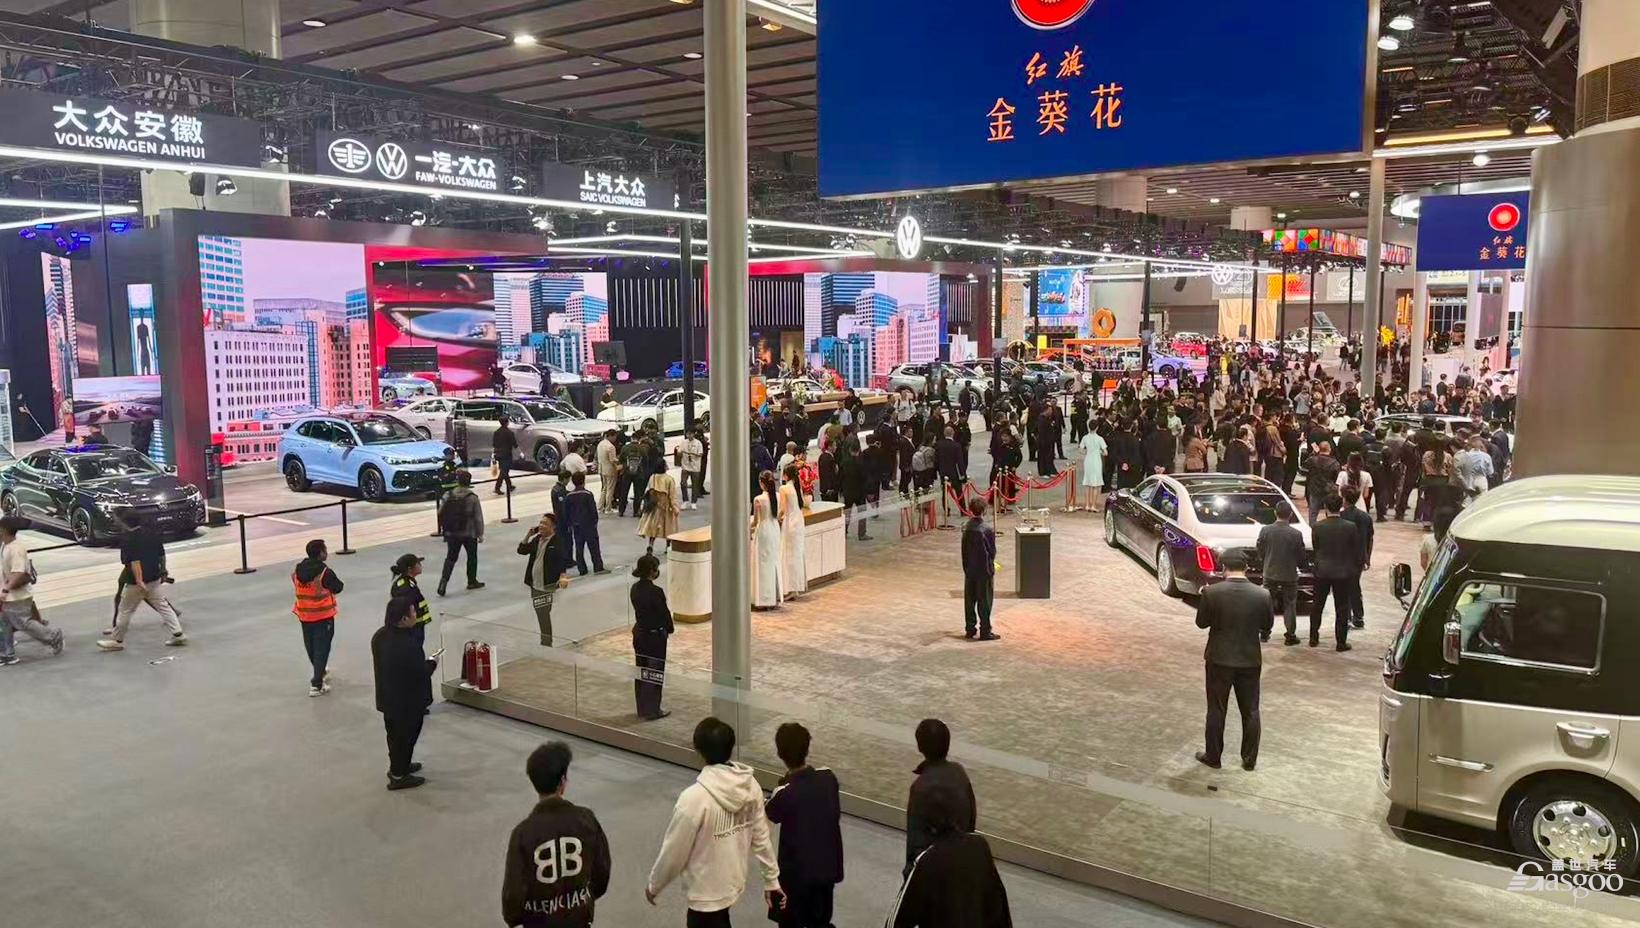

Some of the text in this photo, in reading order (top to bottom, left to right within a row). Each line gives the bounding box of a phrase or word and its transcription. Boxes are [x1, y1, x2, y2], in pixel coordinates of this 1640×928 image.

[1025, 44, 1085, 85] 红旗
[52, 100, 204, 145] 大众安徽
[985, 82, 1124, 142] 金葵花
[54, 131, 206, 160] VOLKSWAGEN ANHUI
[415, 171, 497, 191] FAW-VOLKSWAGEN
[579, 170, 646, 197] 上汽大众
[580, 191, 647, 208] SAIC VOLKSWAGEN
[1480, 246, 1526, 260] 金葵花
